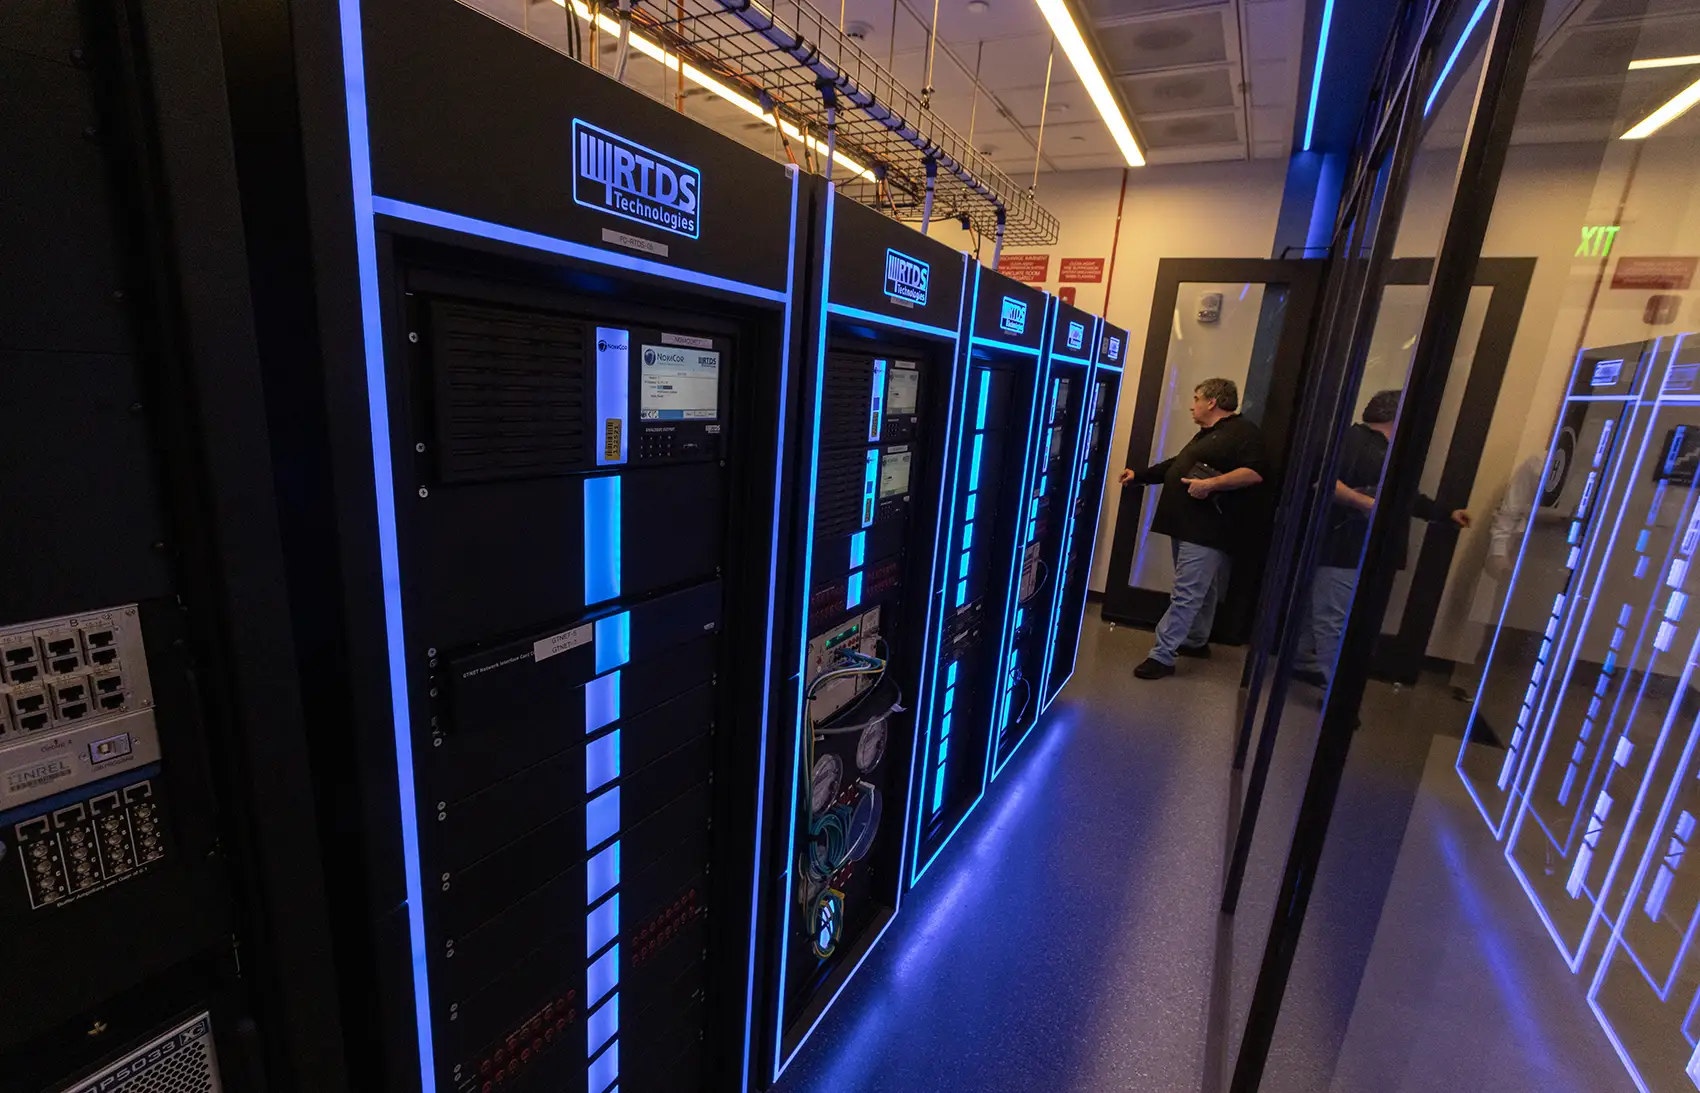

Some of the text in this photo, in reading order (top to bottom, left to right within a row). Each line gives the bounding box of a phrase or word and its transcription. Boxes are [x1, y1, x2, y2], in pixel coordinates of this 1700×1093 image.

[613, 145, 696, 214] RTDS
[613, 190, 695, 232] Technologies
[70, 619, 79, 627] B
[22, 761, 69, 779] NREL
